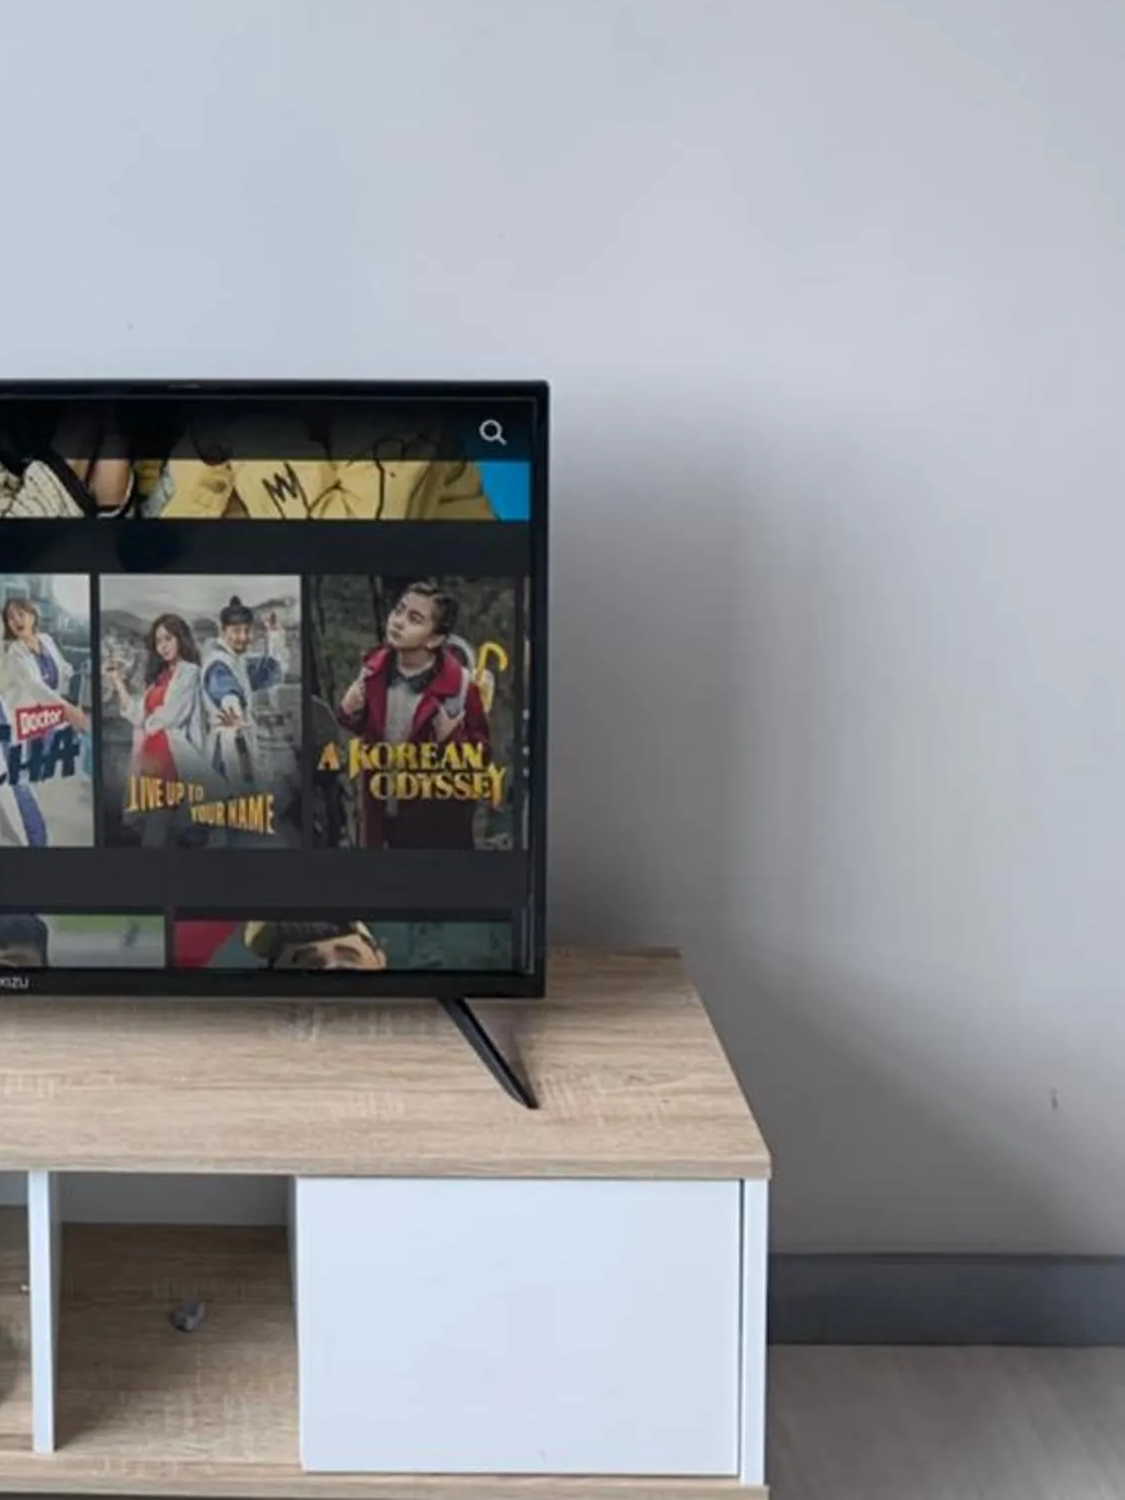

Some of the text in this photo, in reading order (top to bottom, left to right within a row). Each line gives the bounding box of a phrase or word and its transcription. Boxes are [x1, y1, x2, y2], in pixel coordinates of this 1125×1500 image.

[318, 737, 484, 780] A KOREAN
[166, 780, 185, 807] UP
[187, 783, 204, 803] TO
[369, 762, 507, 810] ODYSSEY
[190, 792, 277, 836] YOUR NAME
